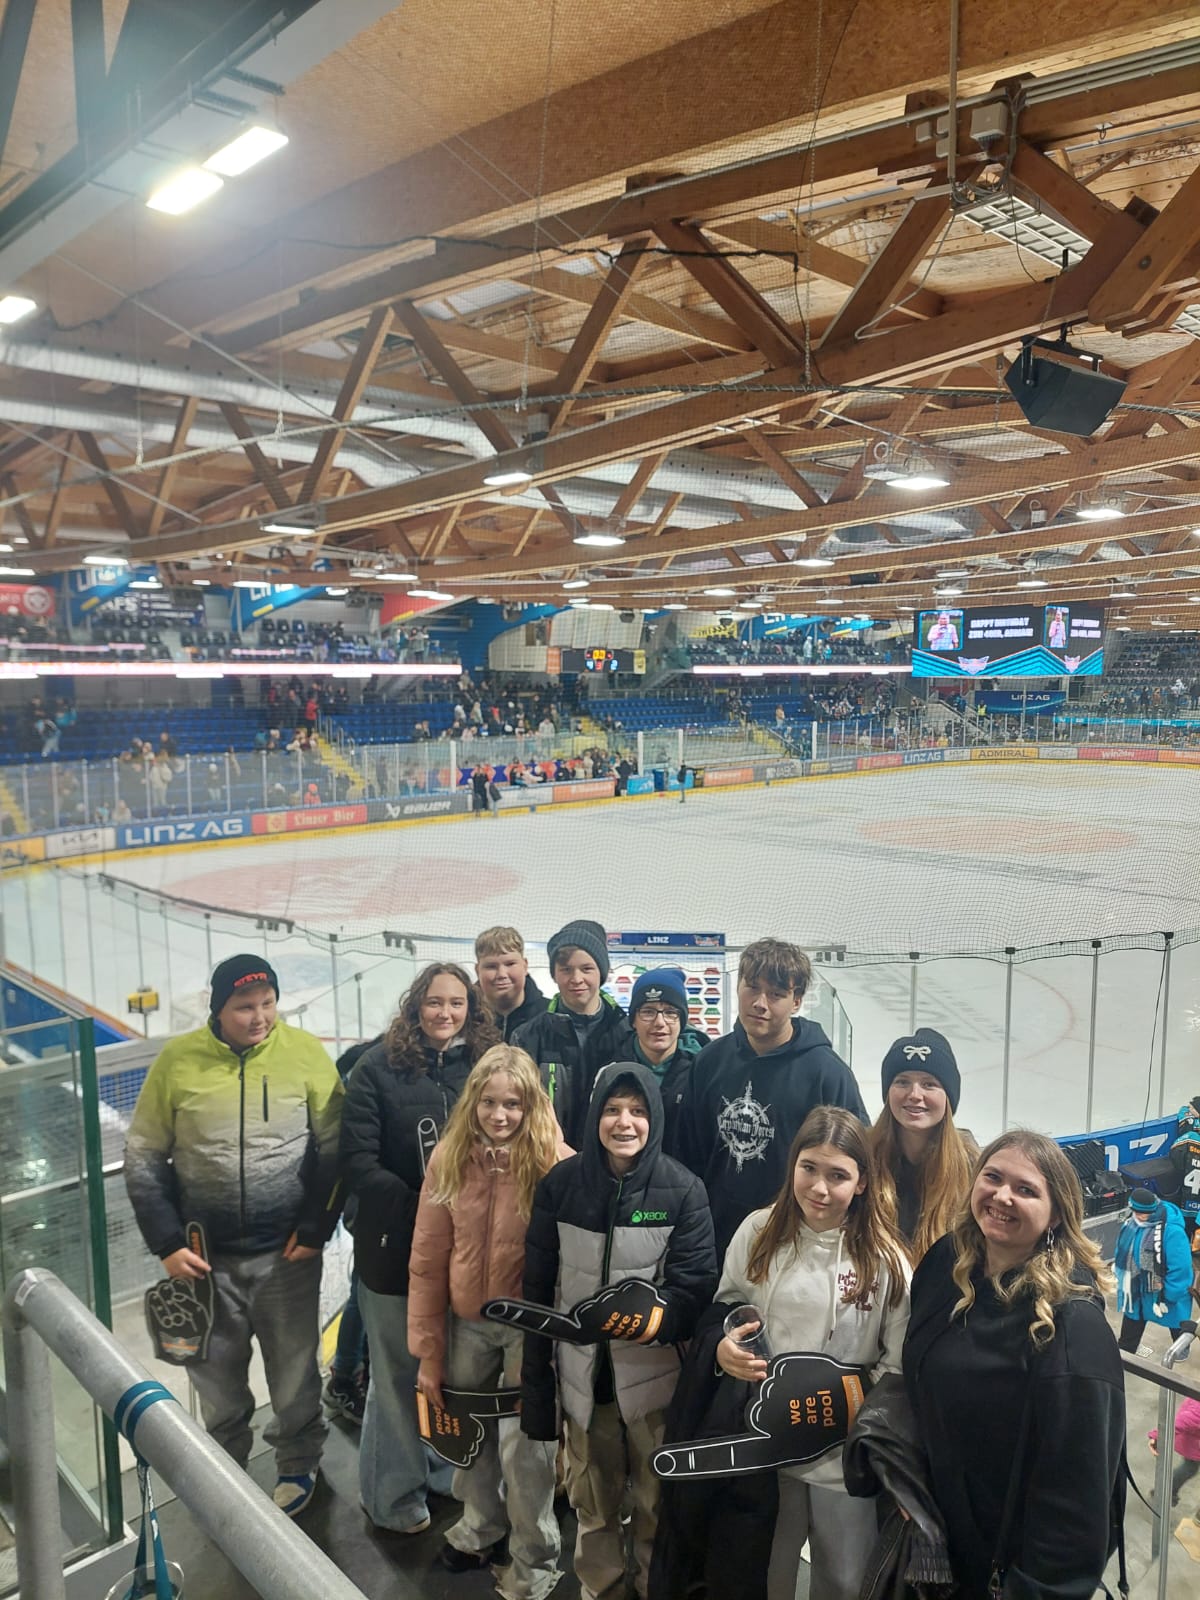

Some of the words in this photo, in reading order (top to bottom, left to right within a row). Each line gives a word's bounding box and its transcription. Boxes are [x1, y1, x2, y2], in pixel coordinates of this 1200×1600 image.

[904, 753, 926, 765] LINZ
[927, 751, 941, 761] AG
[978, 749, 1030, 758] ADMIRAL
[125, 822, 197, 846] LINZ
[201, 818, 244, 839] AG
[643, 1211, 668, 1221] XBOX
[789, 1399, 802, 1426] we
[805, 1396, 818, 1425] are
[817, 1390, 837, 1427] pool
